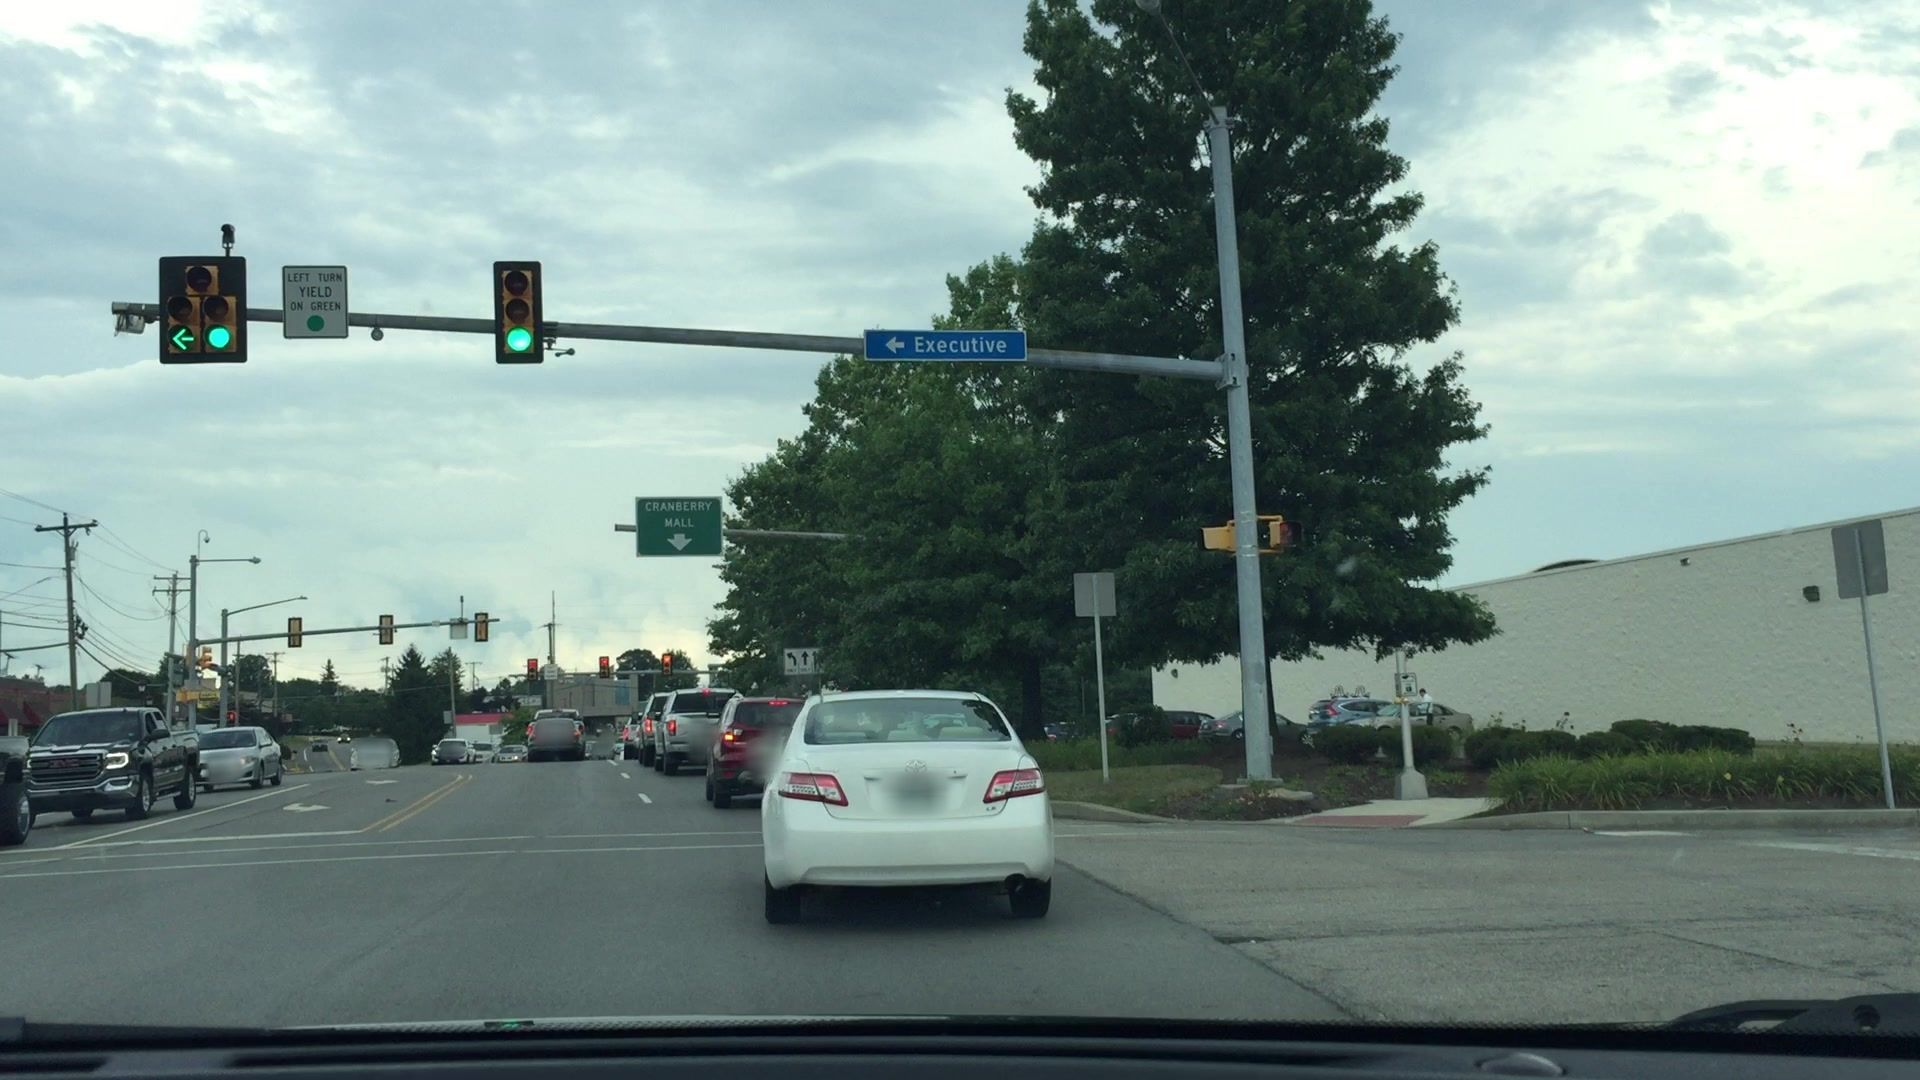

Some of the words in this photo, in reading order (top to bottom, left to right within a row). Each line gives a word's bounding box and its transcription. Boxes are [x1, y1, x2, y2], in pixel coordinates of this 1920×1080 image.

[287, 273, 309, 282] LEFT
[318, 273, 342, 282] TURN
[299, 286, 332, 298] YIELD
[290, 301, 303, 311] ON
[310, 301, 341, 311] GREEN
[914, 336, 1007, 353] Executive
[645, 501, 713, 512] CRANBERRY
[664, 518, 694, 528] MALL
